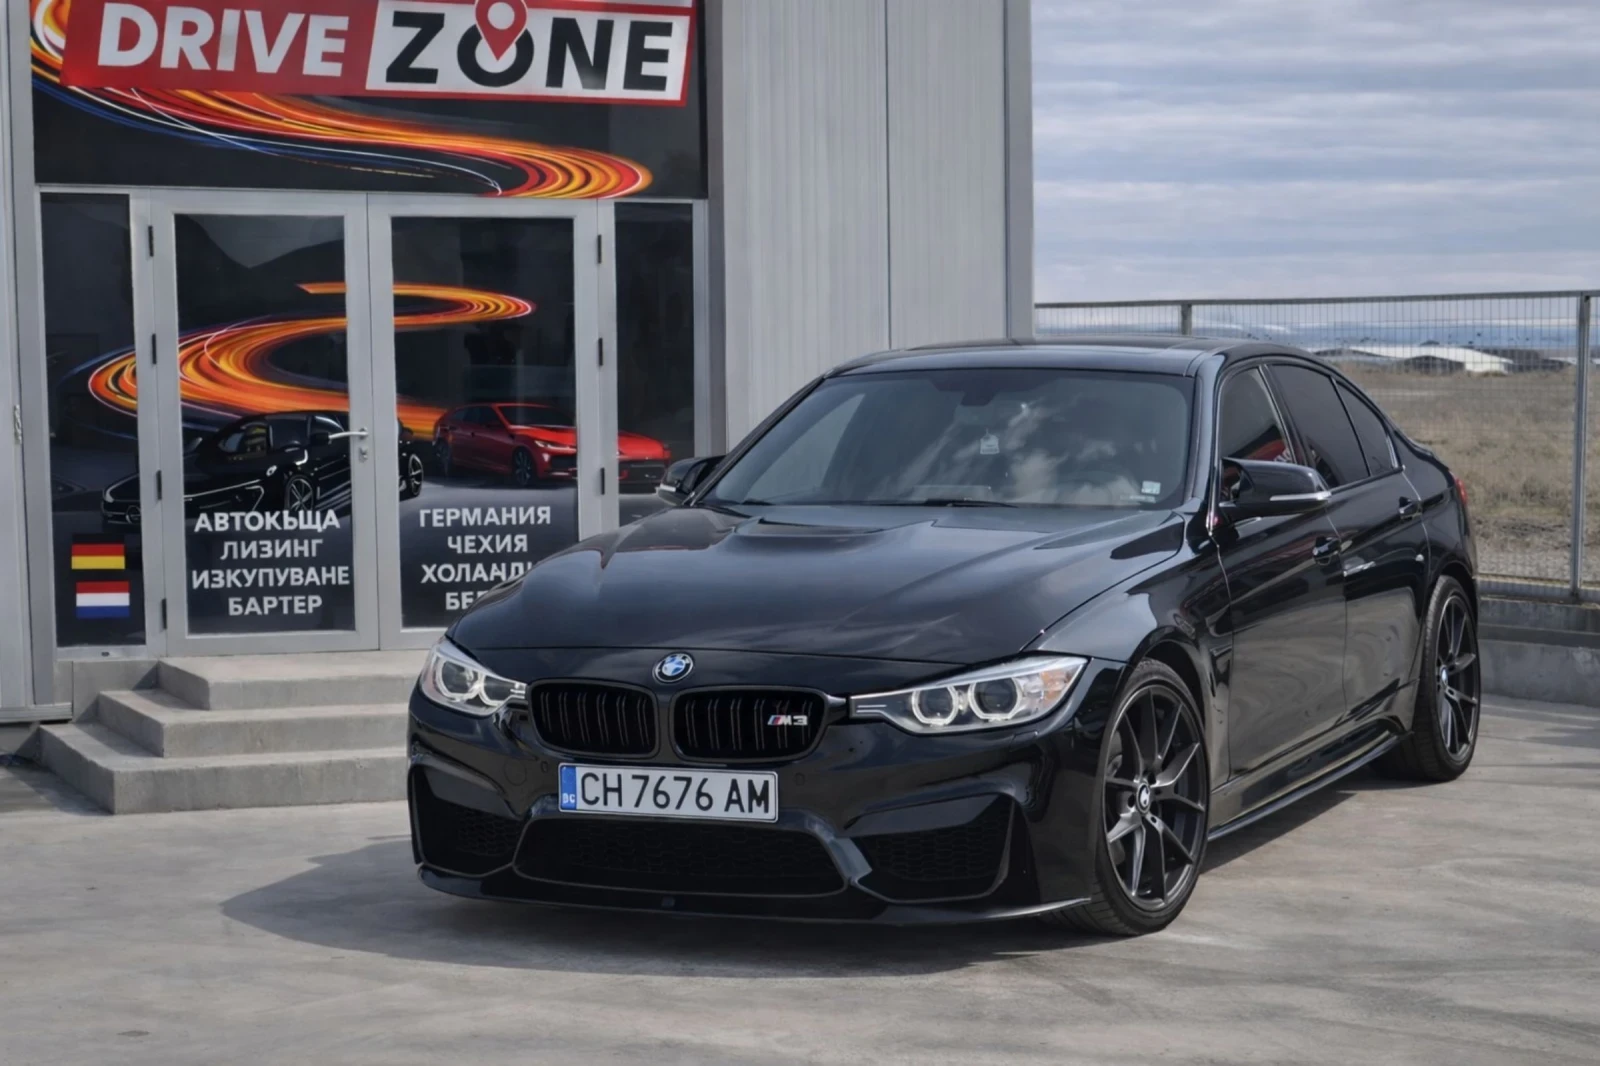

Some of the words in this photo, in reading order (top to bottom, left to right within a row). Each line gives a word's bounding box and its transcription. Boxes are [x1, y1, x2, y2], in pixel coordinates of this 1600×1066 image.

[97, 2, 350, 77] DRIVE
[385, 10, 673, 92] ZONE
[419, 505, 551, 528] ГЕРМАНИЯ
[220, 538, 323, 560] ЛИЗИНГ
[447, 534, 528, 554] ЧЕХИЯ
[191, 566, 350, 589] ИЗКУПУВАНЕ
[420, 561, 533, 584] ХОЛАНД
[228, 594, 323, 616] БАРТЕР
[767, 714, 808, 726] M3
[580, 772, 623, 807] CH
[631, 774, 714, 812] 7676
[723, 778, 770, 814] AM
